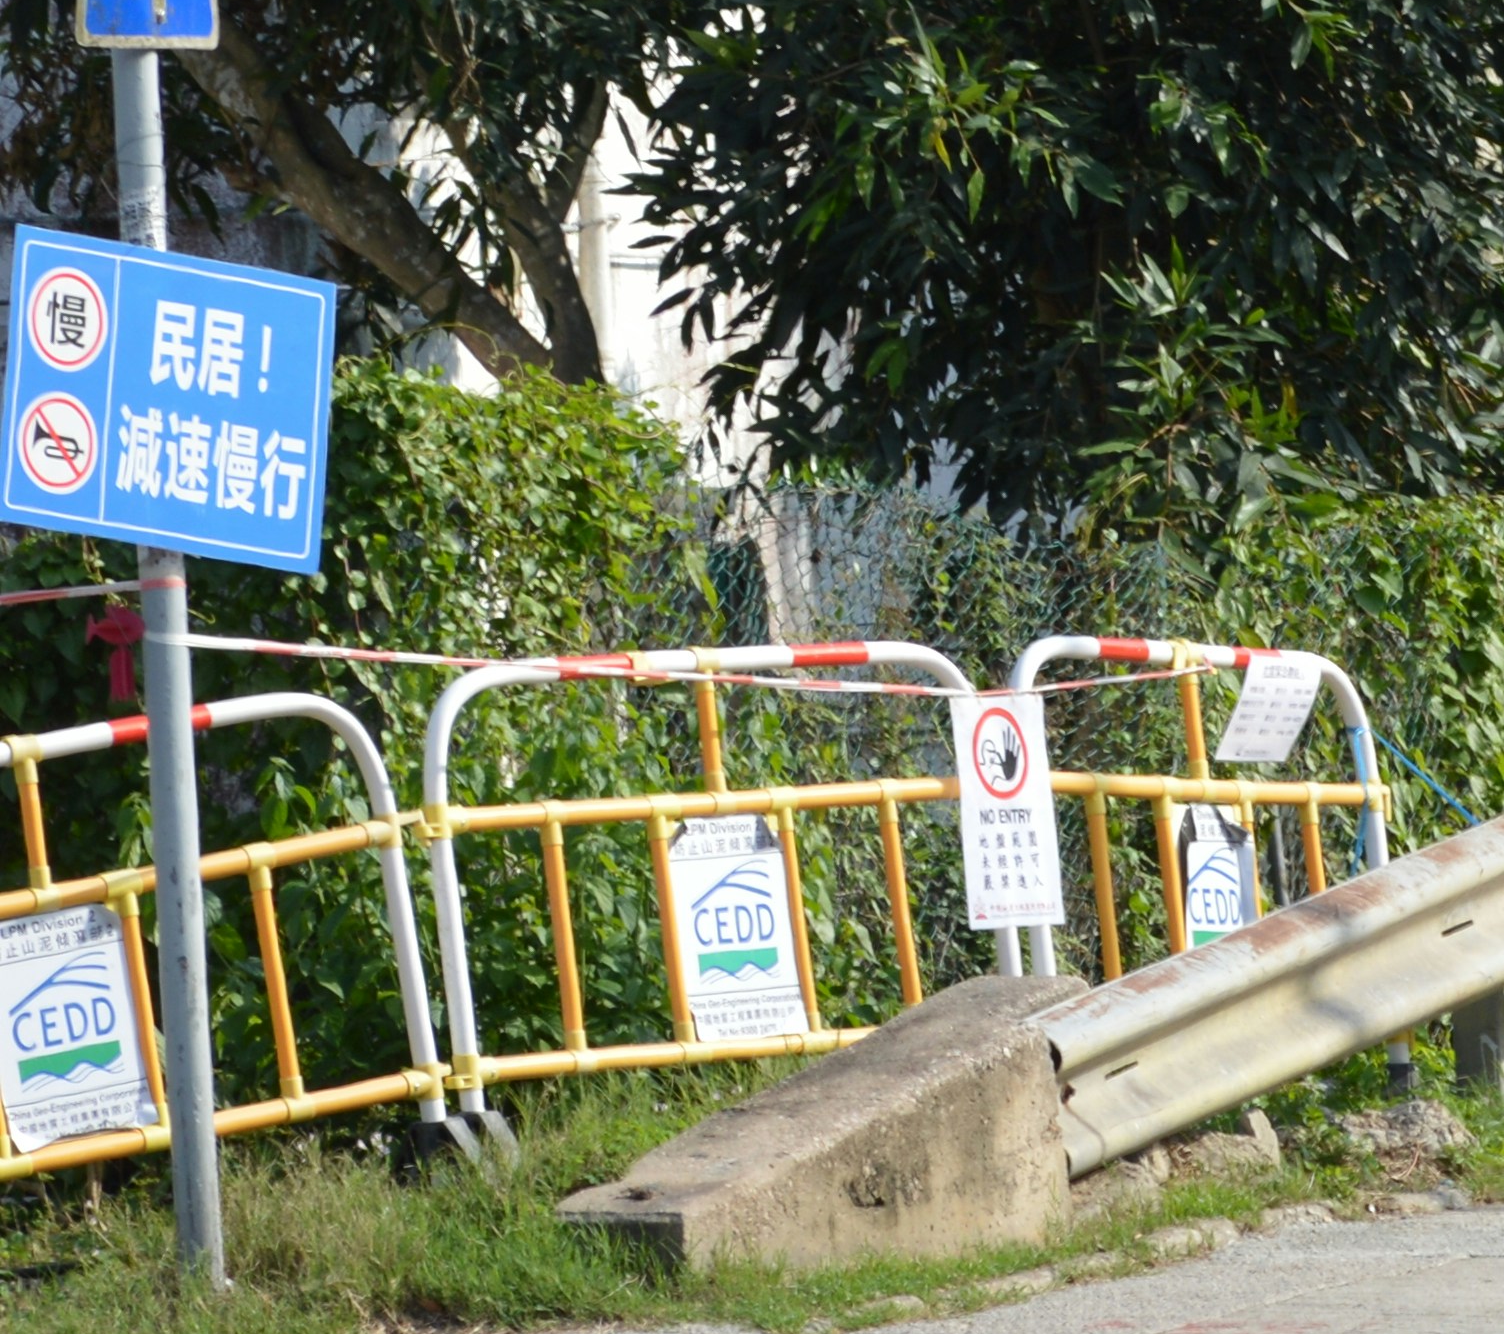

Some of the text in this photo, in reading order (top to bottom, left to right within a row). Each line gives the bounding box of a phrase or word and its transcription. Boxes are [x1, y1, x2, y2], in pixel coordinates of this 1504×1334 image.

[46, 291, 86, 349] 慢
[115, 403, 306, 520] 減速慢行
[709, 821, 752, 835] Division
[979, 807, 1033, 825] NO ENTRY
[0, 909, 97, 940] LPM Division 2
[694, 903, 775, 947] CEDD
[1188, 887, 1240, 925] CEDD
[12, 996, 116, 1052] CEDD
